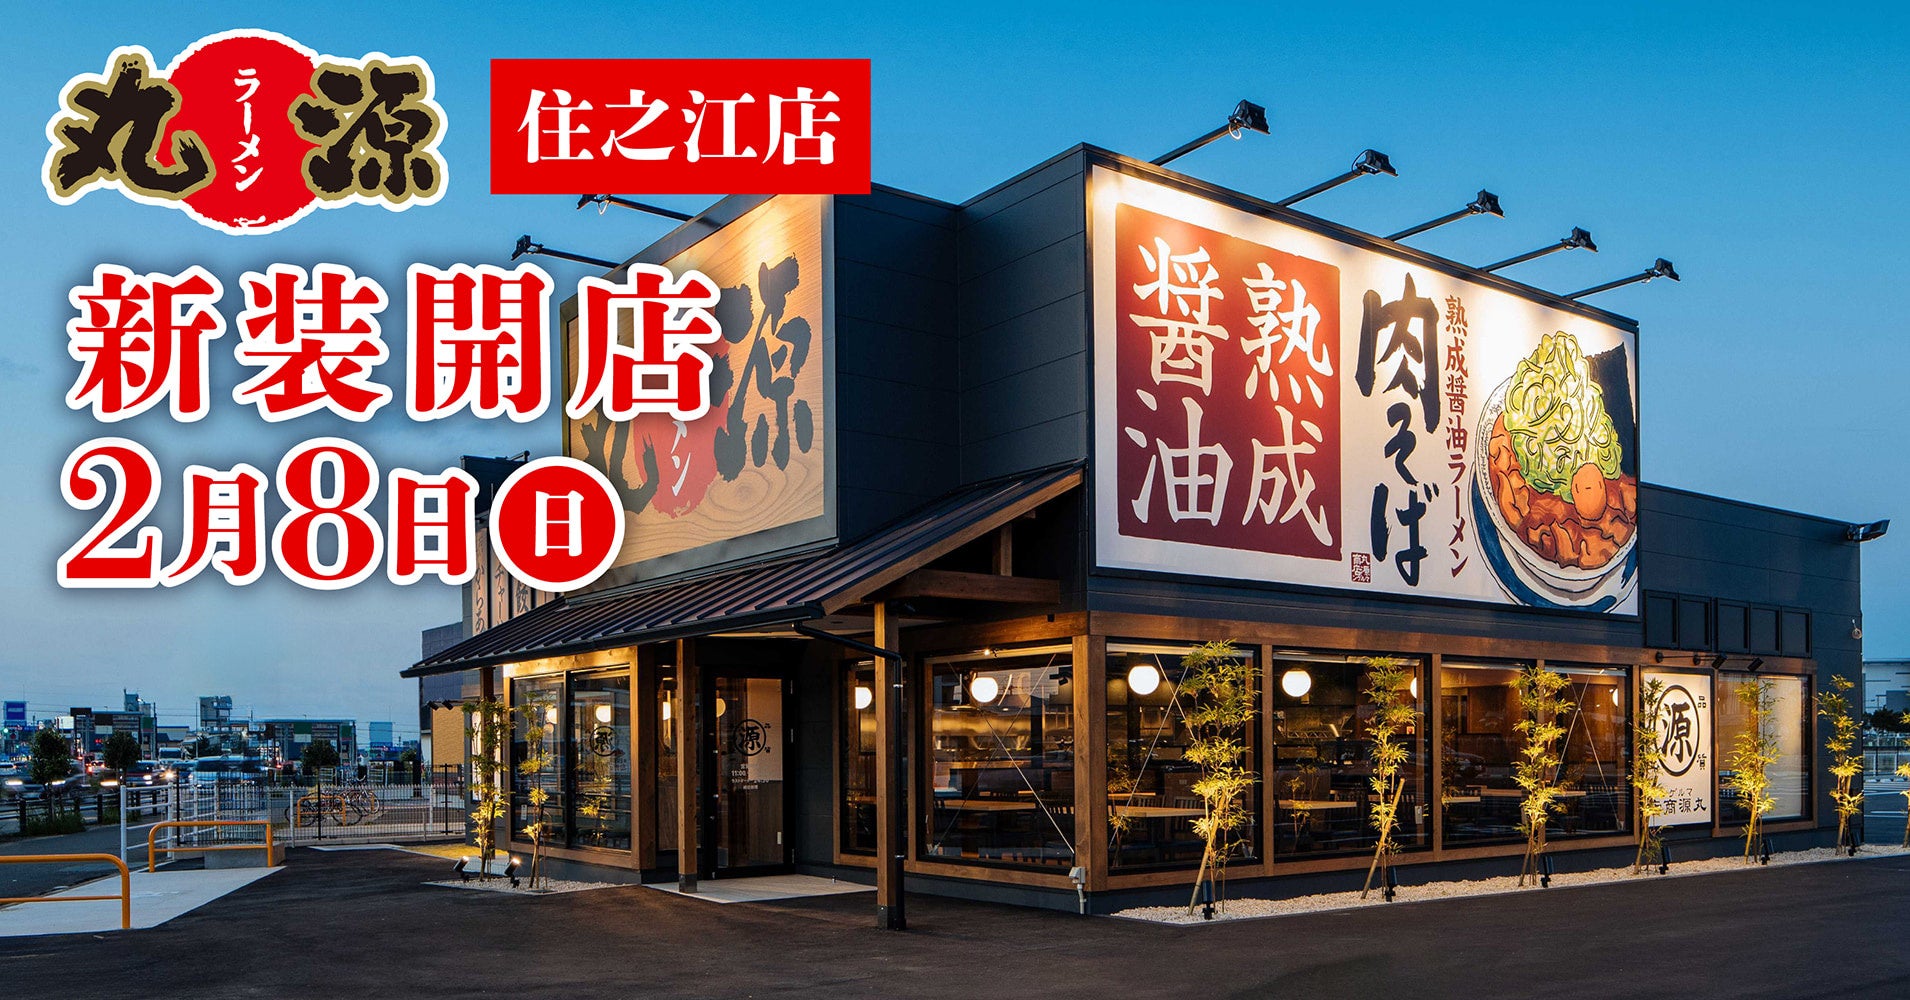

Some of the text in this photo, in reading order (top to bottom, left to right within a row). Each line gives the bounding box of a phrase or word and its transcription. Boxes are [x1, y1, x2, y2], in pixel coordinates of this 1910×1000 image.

[1125, 236, 1232, 527] 醤油
[1238, 262, 1334, 546] 熟成
[1354, 272, 1441, 587] 肉そば
[1444, 294, 1470, 579] 熟成醤油ラーメン
[1662, 701, 1694, 763] 源
